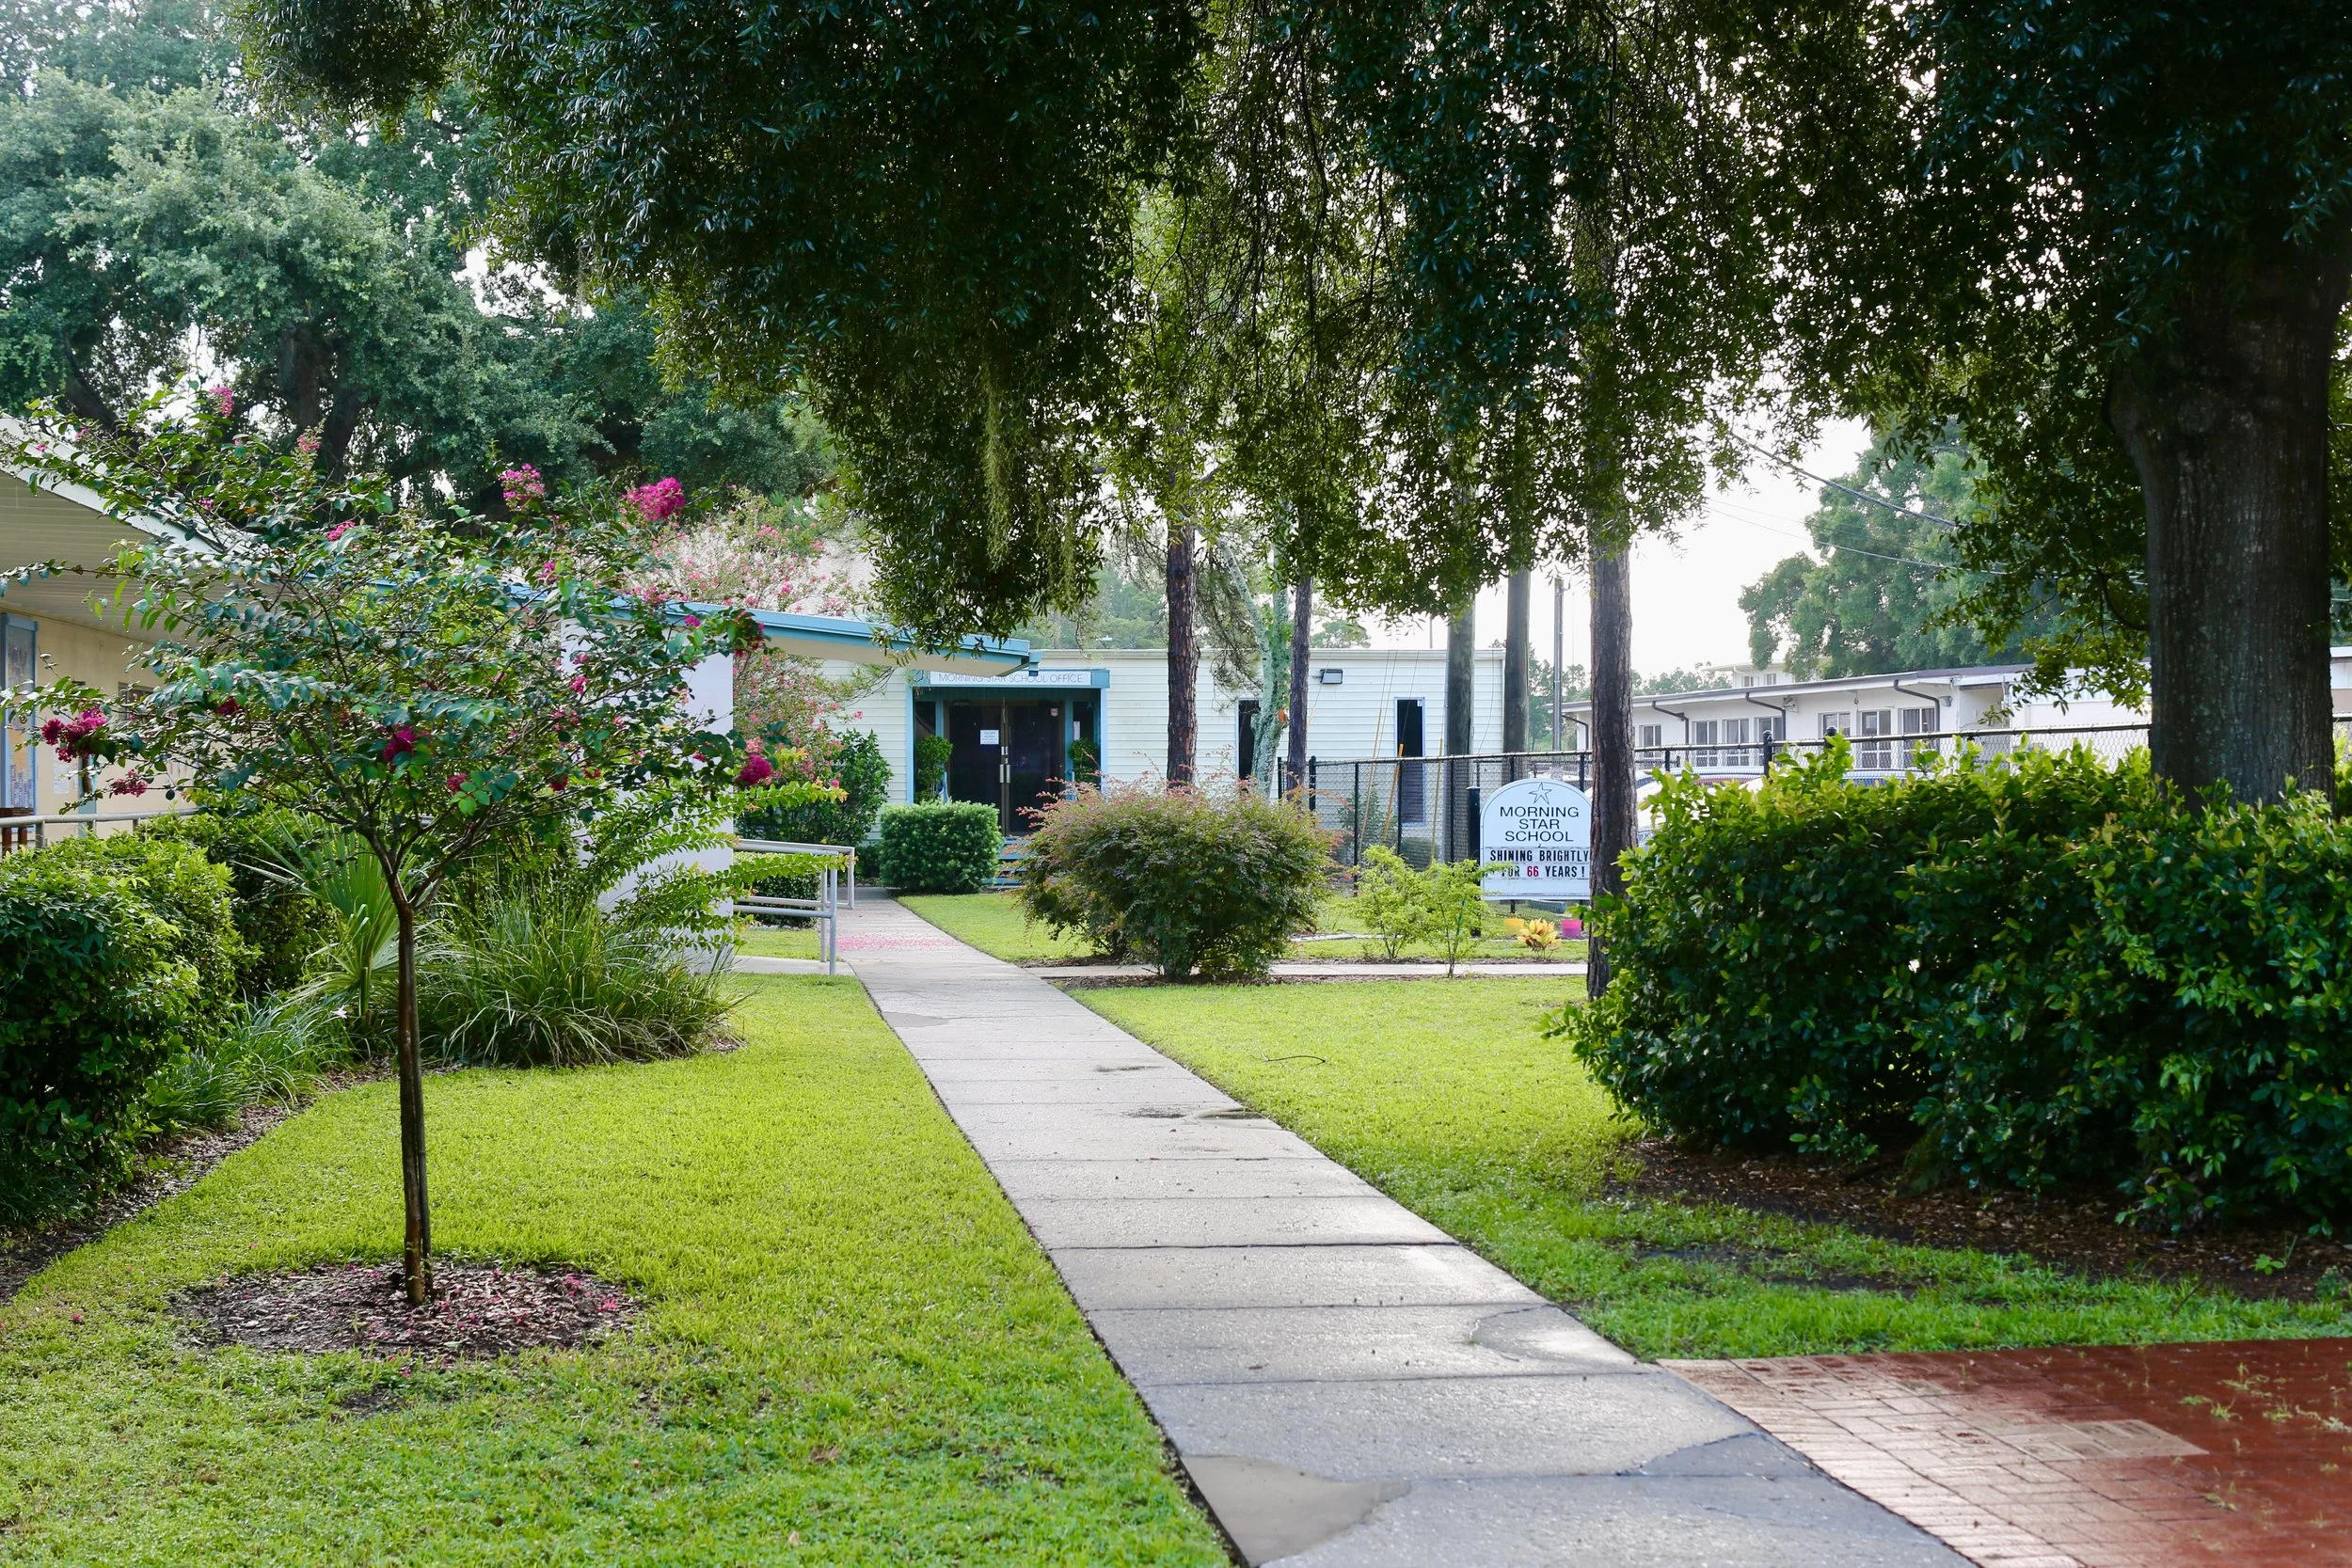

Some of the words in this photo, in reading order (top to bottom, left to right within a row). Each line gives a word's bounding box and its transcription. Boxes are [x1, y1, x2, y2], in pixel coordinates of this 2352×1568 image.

[939, 673, 983, 682] MORNING
[1009, 673, 1046, 683] SCHOOL
[1050, 673, 1082, 683] OFFICE
[1500, 806, 1579, 817] MORNING
[1518, 818, 1560, 830] STAR
[1504, 831, 1574, 842] SCHOOL
[1490, 849, 1533, 862] SHINING
[1539, 849, 1589, 862] BRIGHTLY
[1527, 865, 1539, 877] 66
